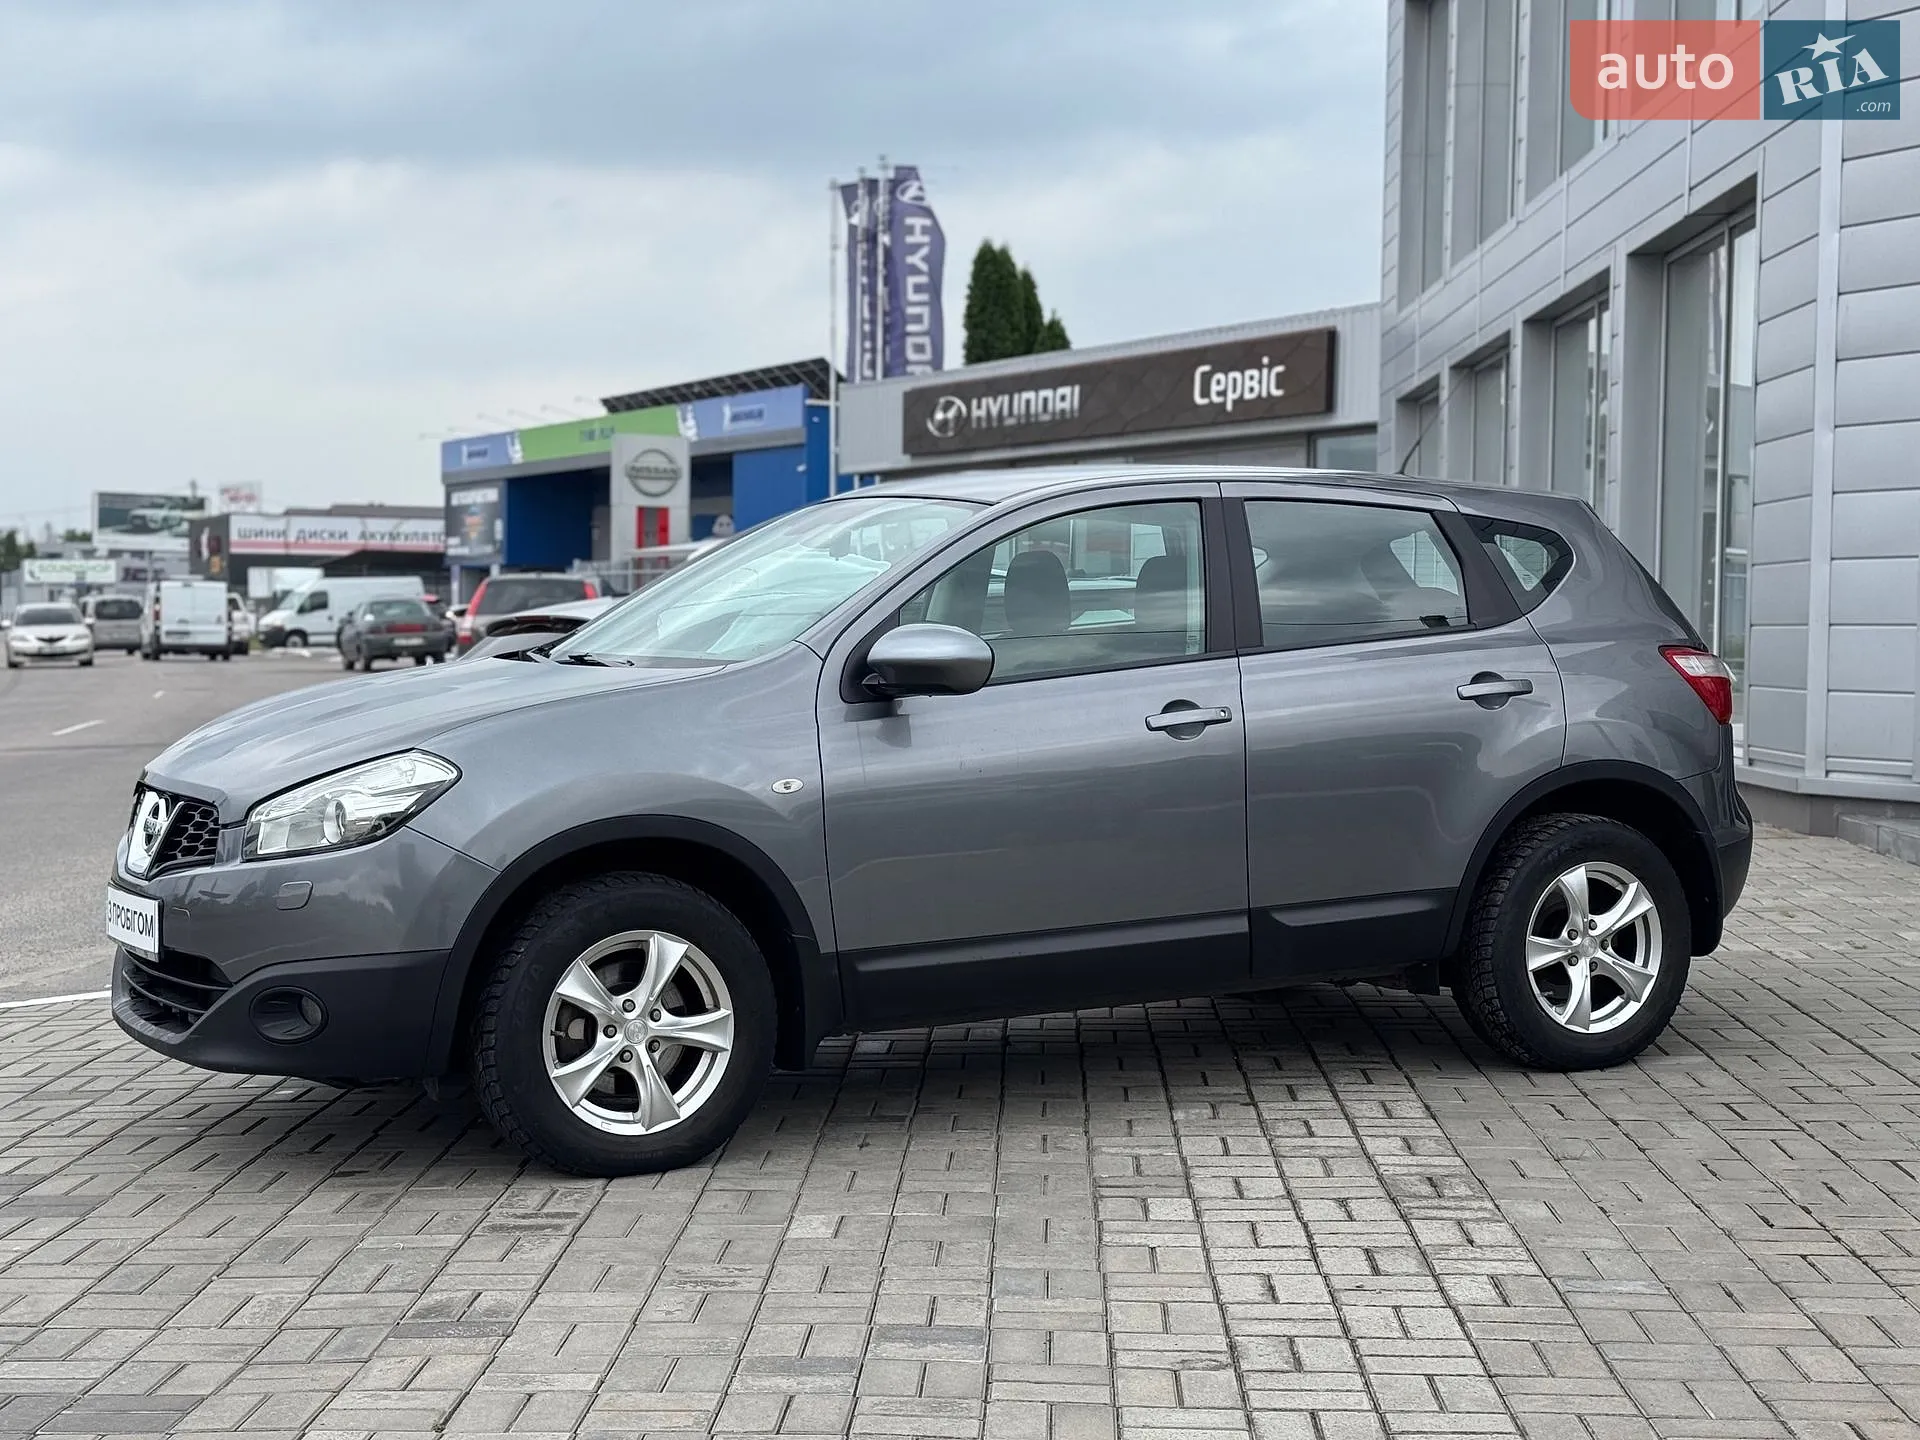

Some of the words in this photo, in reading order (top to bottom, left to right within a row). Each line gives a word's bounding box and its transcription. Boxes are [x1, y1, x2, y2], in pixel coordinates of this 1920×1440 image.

[1193, 357, 1286, 413] Сервіс
[972, 385, 1081, 429] HYUNDAI
[237, 526, 287, 540] ШИНИ
[296, 527, 349, 544] ДИСКИ
[112, 902, 154, 938] ПРОБІГОМ
